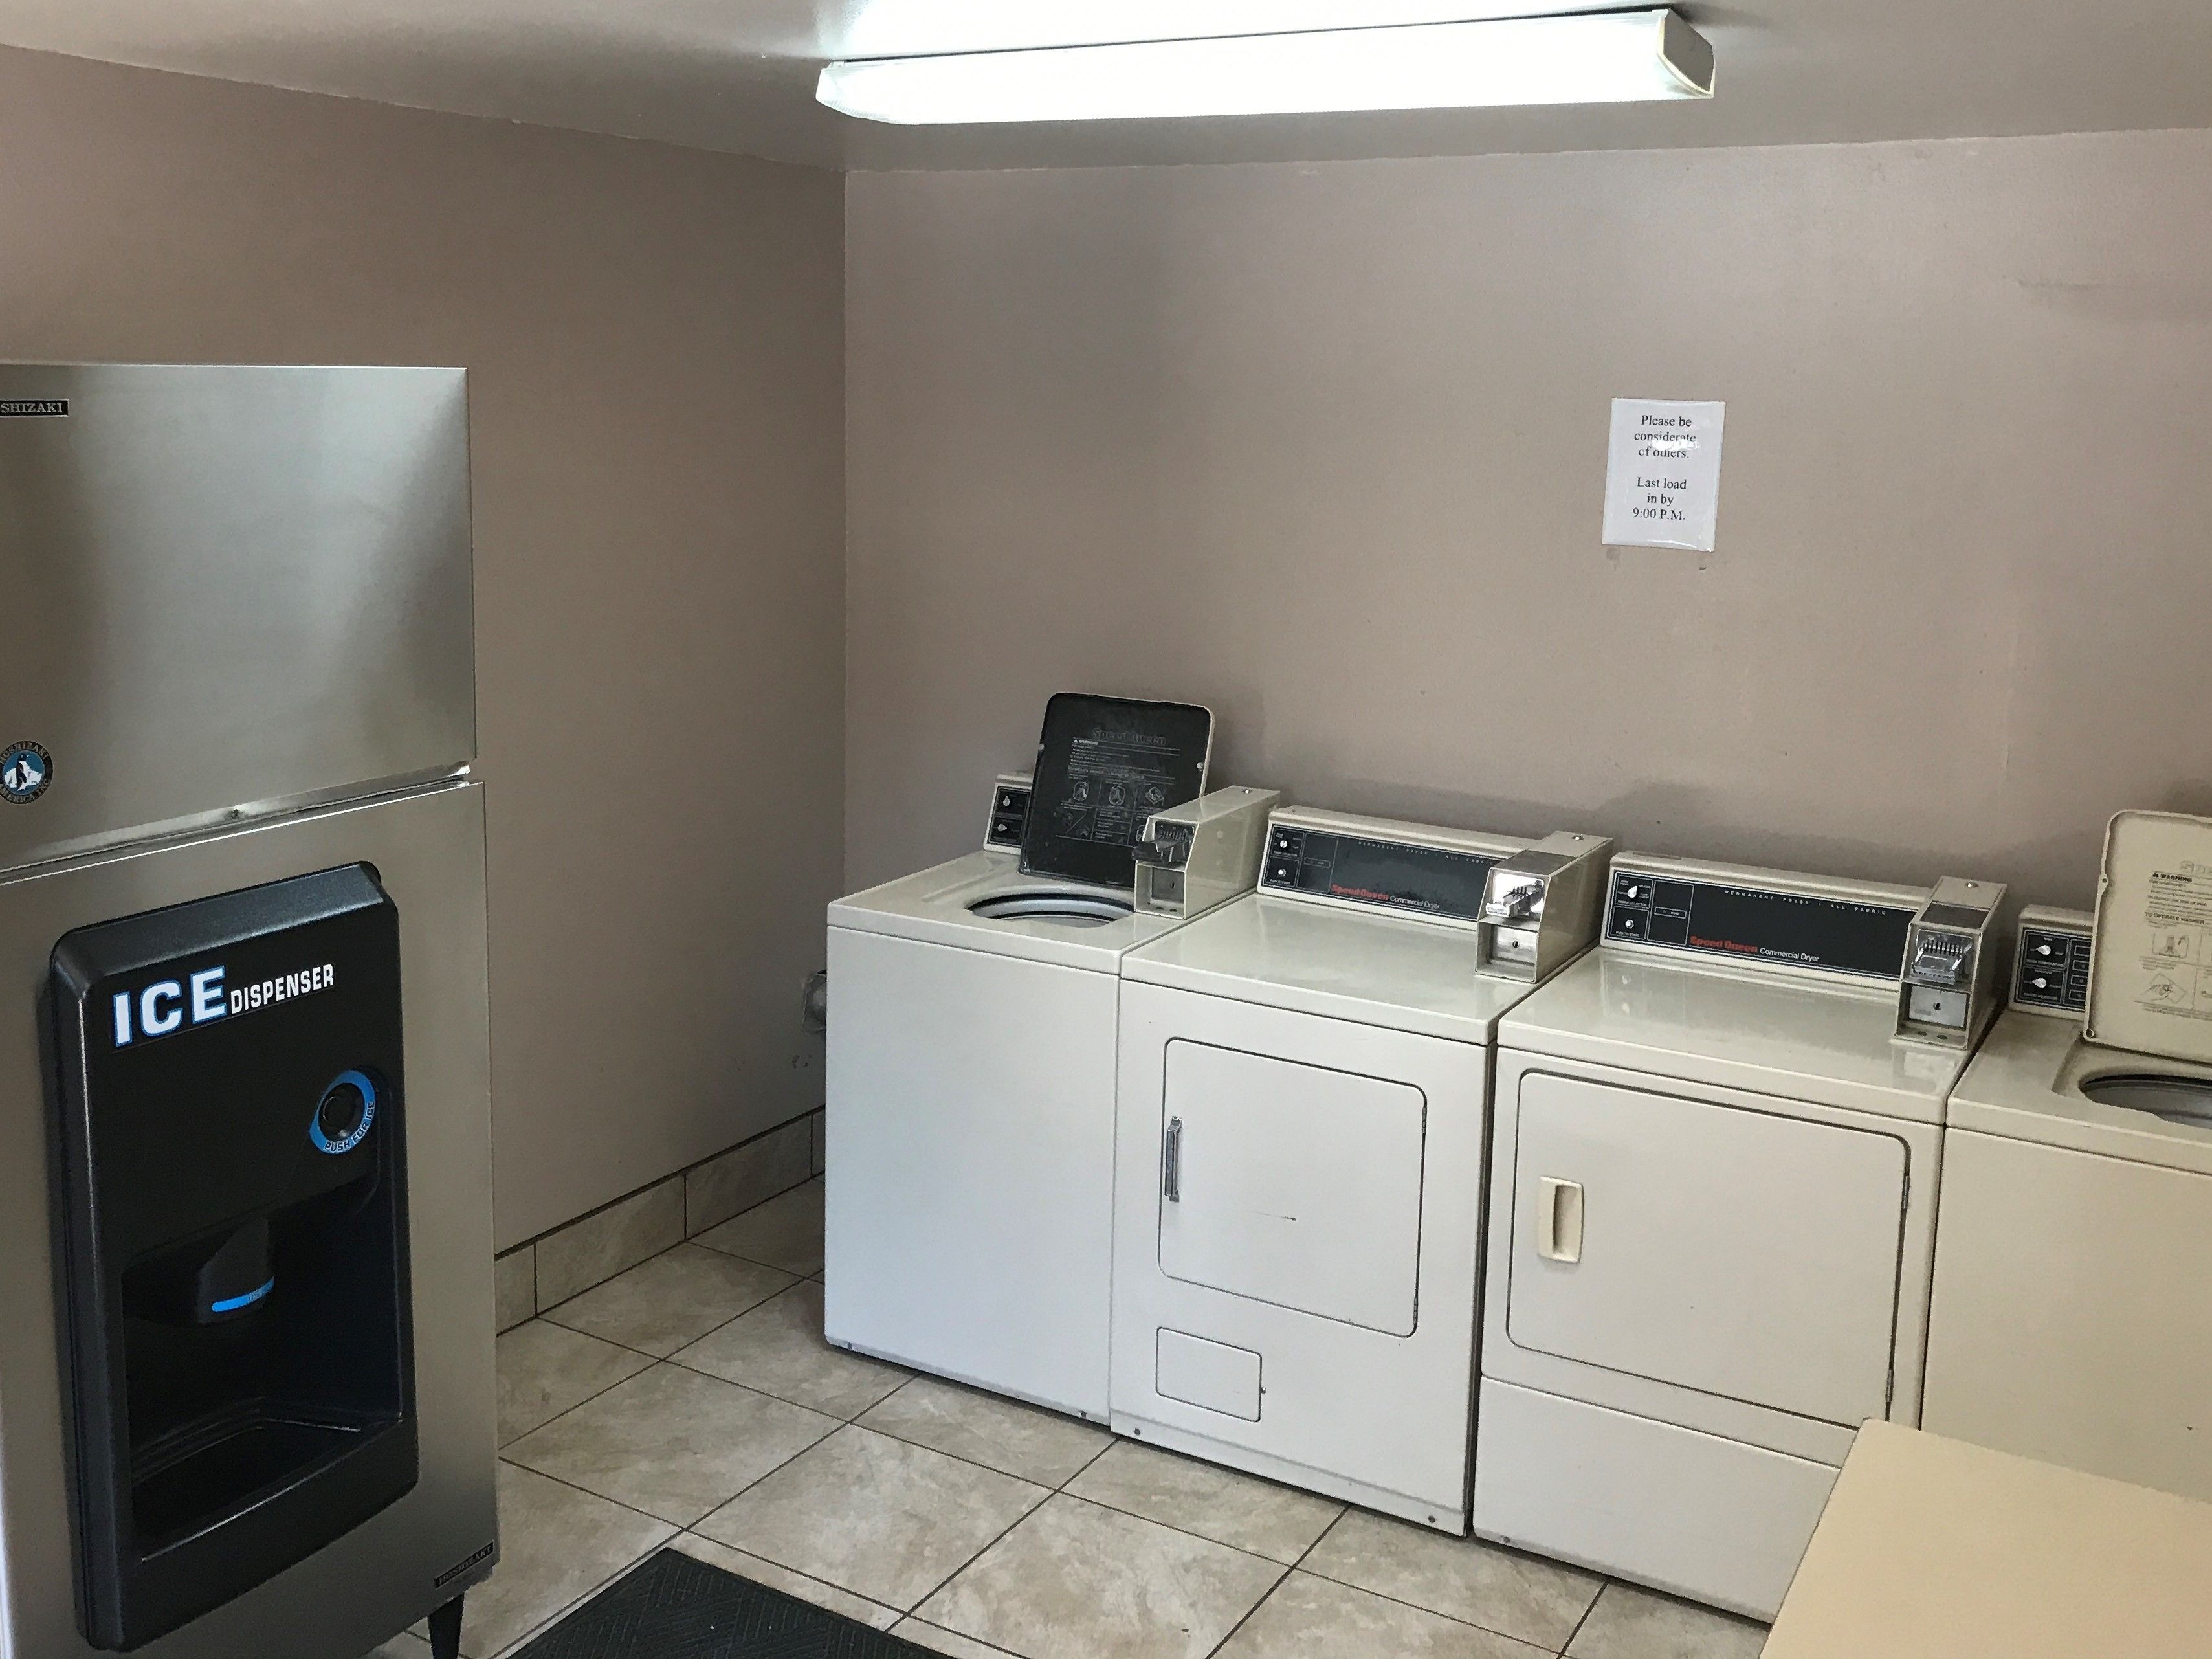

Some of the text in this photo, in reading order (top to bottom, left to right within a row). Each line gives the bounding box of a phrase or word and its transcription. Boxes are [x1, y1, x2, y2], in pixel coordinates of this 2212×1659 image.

[1641, 415, 1692, 427] Please be
[1634, 430, 1696, 442] considerate
[1638, 446, 1652, 456] of
[1637, 476, 1687, 489] Last load
[1647, 493, 1674, 507] in by
[1632, 507, 1686, 520] 9:00 P.M.
[2161, 874, 2193, 882] WARNING
[1390, 895, 1424, 907] Commercial
[1424, 900, 1441, 909] Dryer
[1690, 935, 1820, 963] Speed Queen Commercial Dryer
[113, 963, 334, 1047] ICE DISPENSER
[324, 1100, 375, 1152] PUSH FOR ICE
